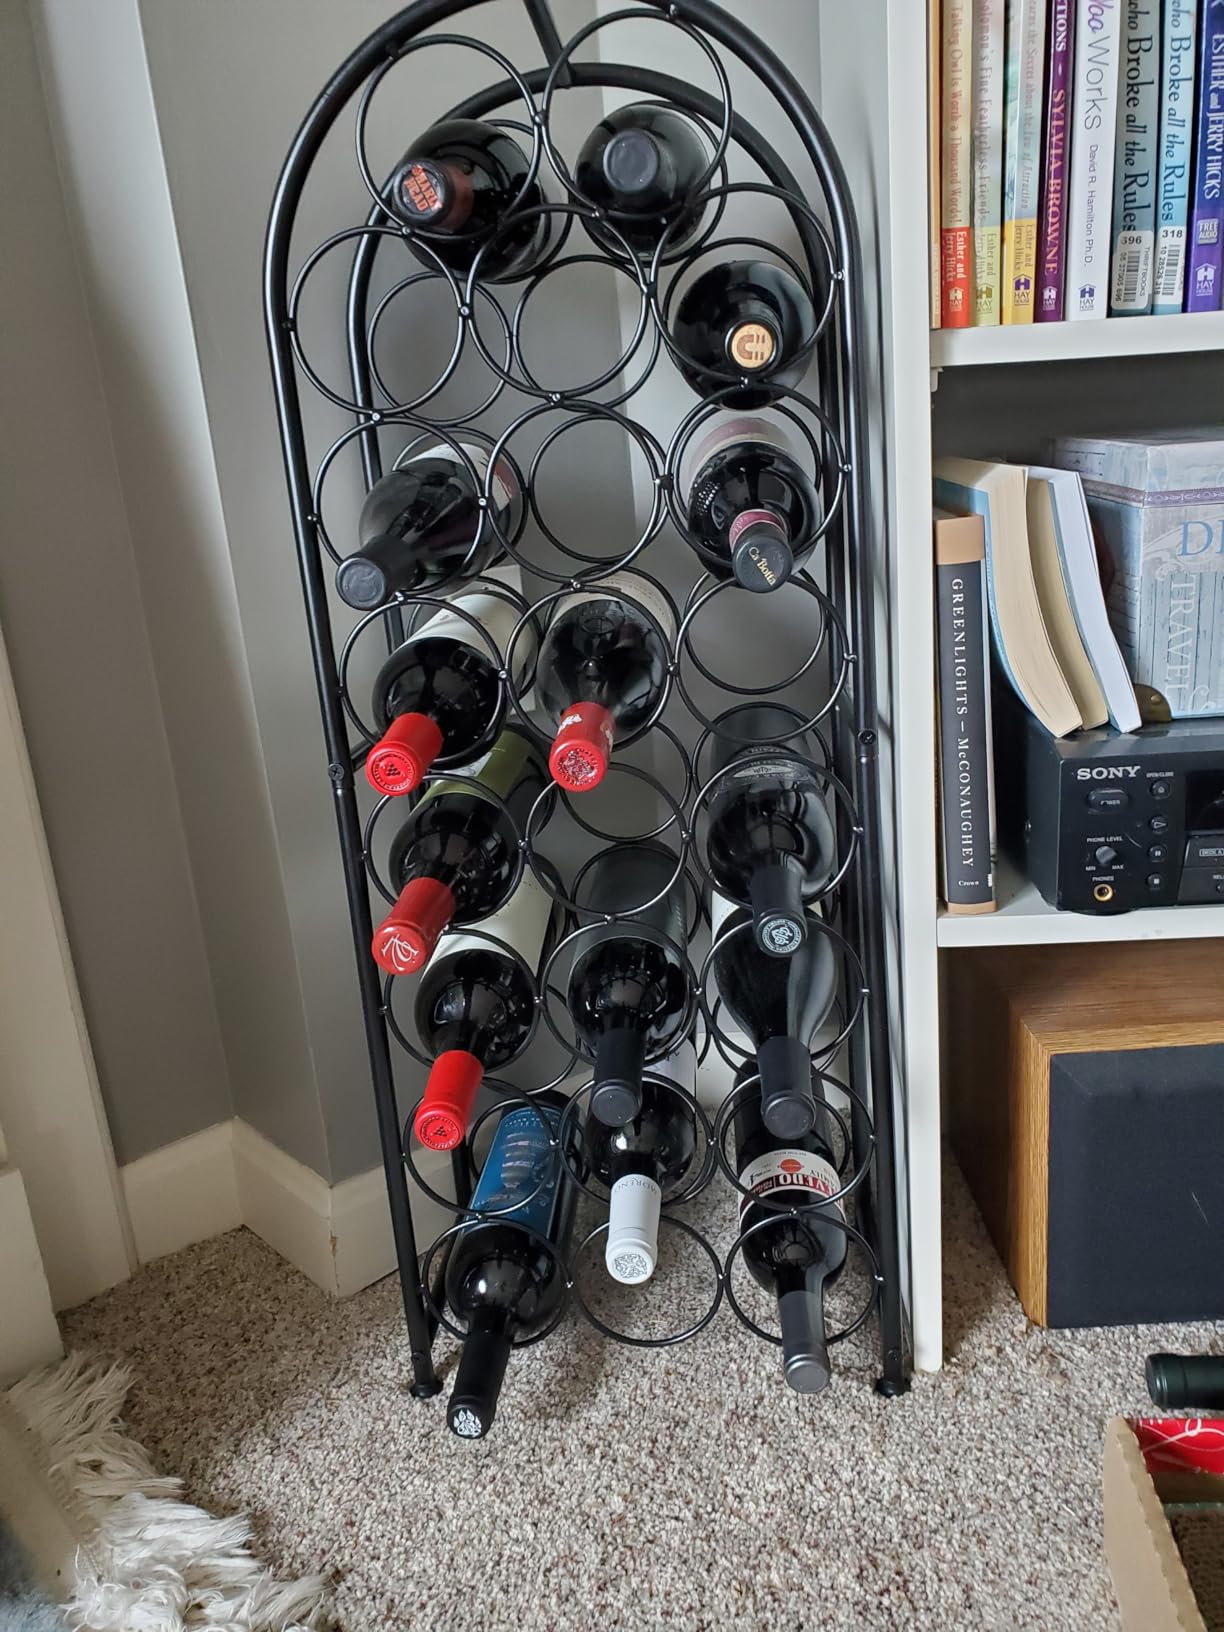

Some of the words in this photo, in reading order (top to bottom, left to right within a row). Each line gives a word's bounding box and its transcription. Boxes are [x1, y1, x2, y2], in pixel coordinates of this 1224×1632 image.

[951, 50, 963, 73] Owl
[1126, 34, 1155, 108] Broke
[1169, 35, 1193, 102] Broke
[1084, 35, 1111, 130] Works
[951, 90, 962, 122] Worth
[1125, 114, 1147, 134] all
[1167, 107, 1186, 128] all
[1051, 89, 1066, 170] SYLVIA
[1165, 133, 1185, 158] the
[1206, 112, 1224, 152] JERRY
[1088, 144, 1098, 173] David
[1123, 140, 1146, 166] the
[1162, 164, 1186, 221] Rules
[1203, 156, 1223, 199] HICKS
[1085, 190, 1096, 235] Hamilton
[1122, 170, 1151, 231] Rules
[957, 231, 967, 259] Esther
[1046, 178, 1062, 276] BROWNE
[1162, 229, 1183, 239] 318
[957, 260, 966, 279] and
[1139, 247, 1150, 297] THRIFTBOOKS
[1197, 280, 1214, 289] HAY
[1014, 292, 1031, 300] HAY
[1180, 520, 1224, 557] D
[951, 578, 969, 715] GREENLIGHTS
[1166, 574, 1197, 697] TRAVEL
[1077, 766, 1141, 780] SONY
[958, 737, 974, 867] McCONAUGHEY
